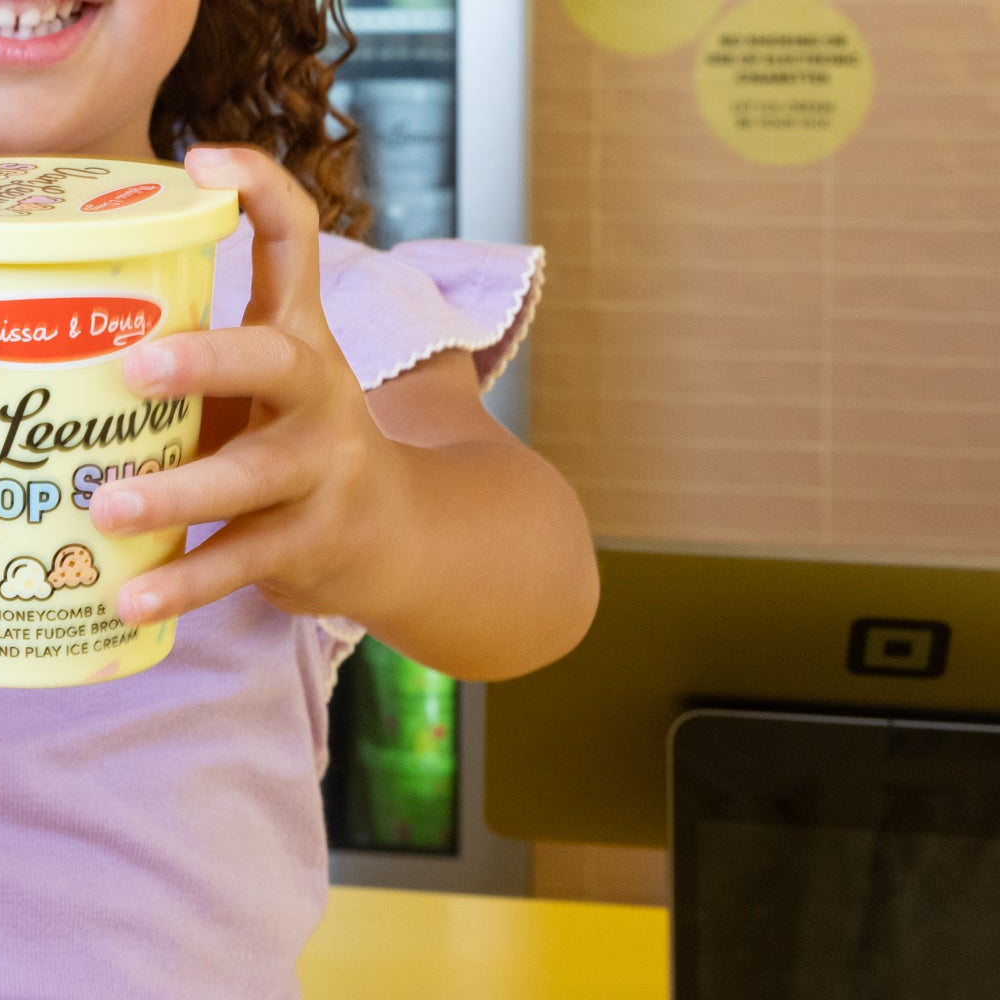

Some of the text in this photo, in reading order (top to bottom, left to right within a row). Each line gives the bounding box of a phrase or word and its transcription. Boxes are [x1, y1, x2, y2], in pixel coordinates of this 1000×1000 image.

[68, 315, 81, 339] &
[96, 603, 107, 616] &
[24, 644, 63, 659] PLAY
[65, 641, 89, 657] ICE
[92, 625, 140, 653] CREAM
[35, 624, 87, 641] FUDGE
